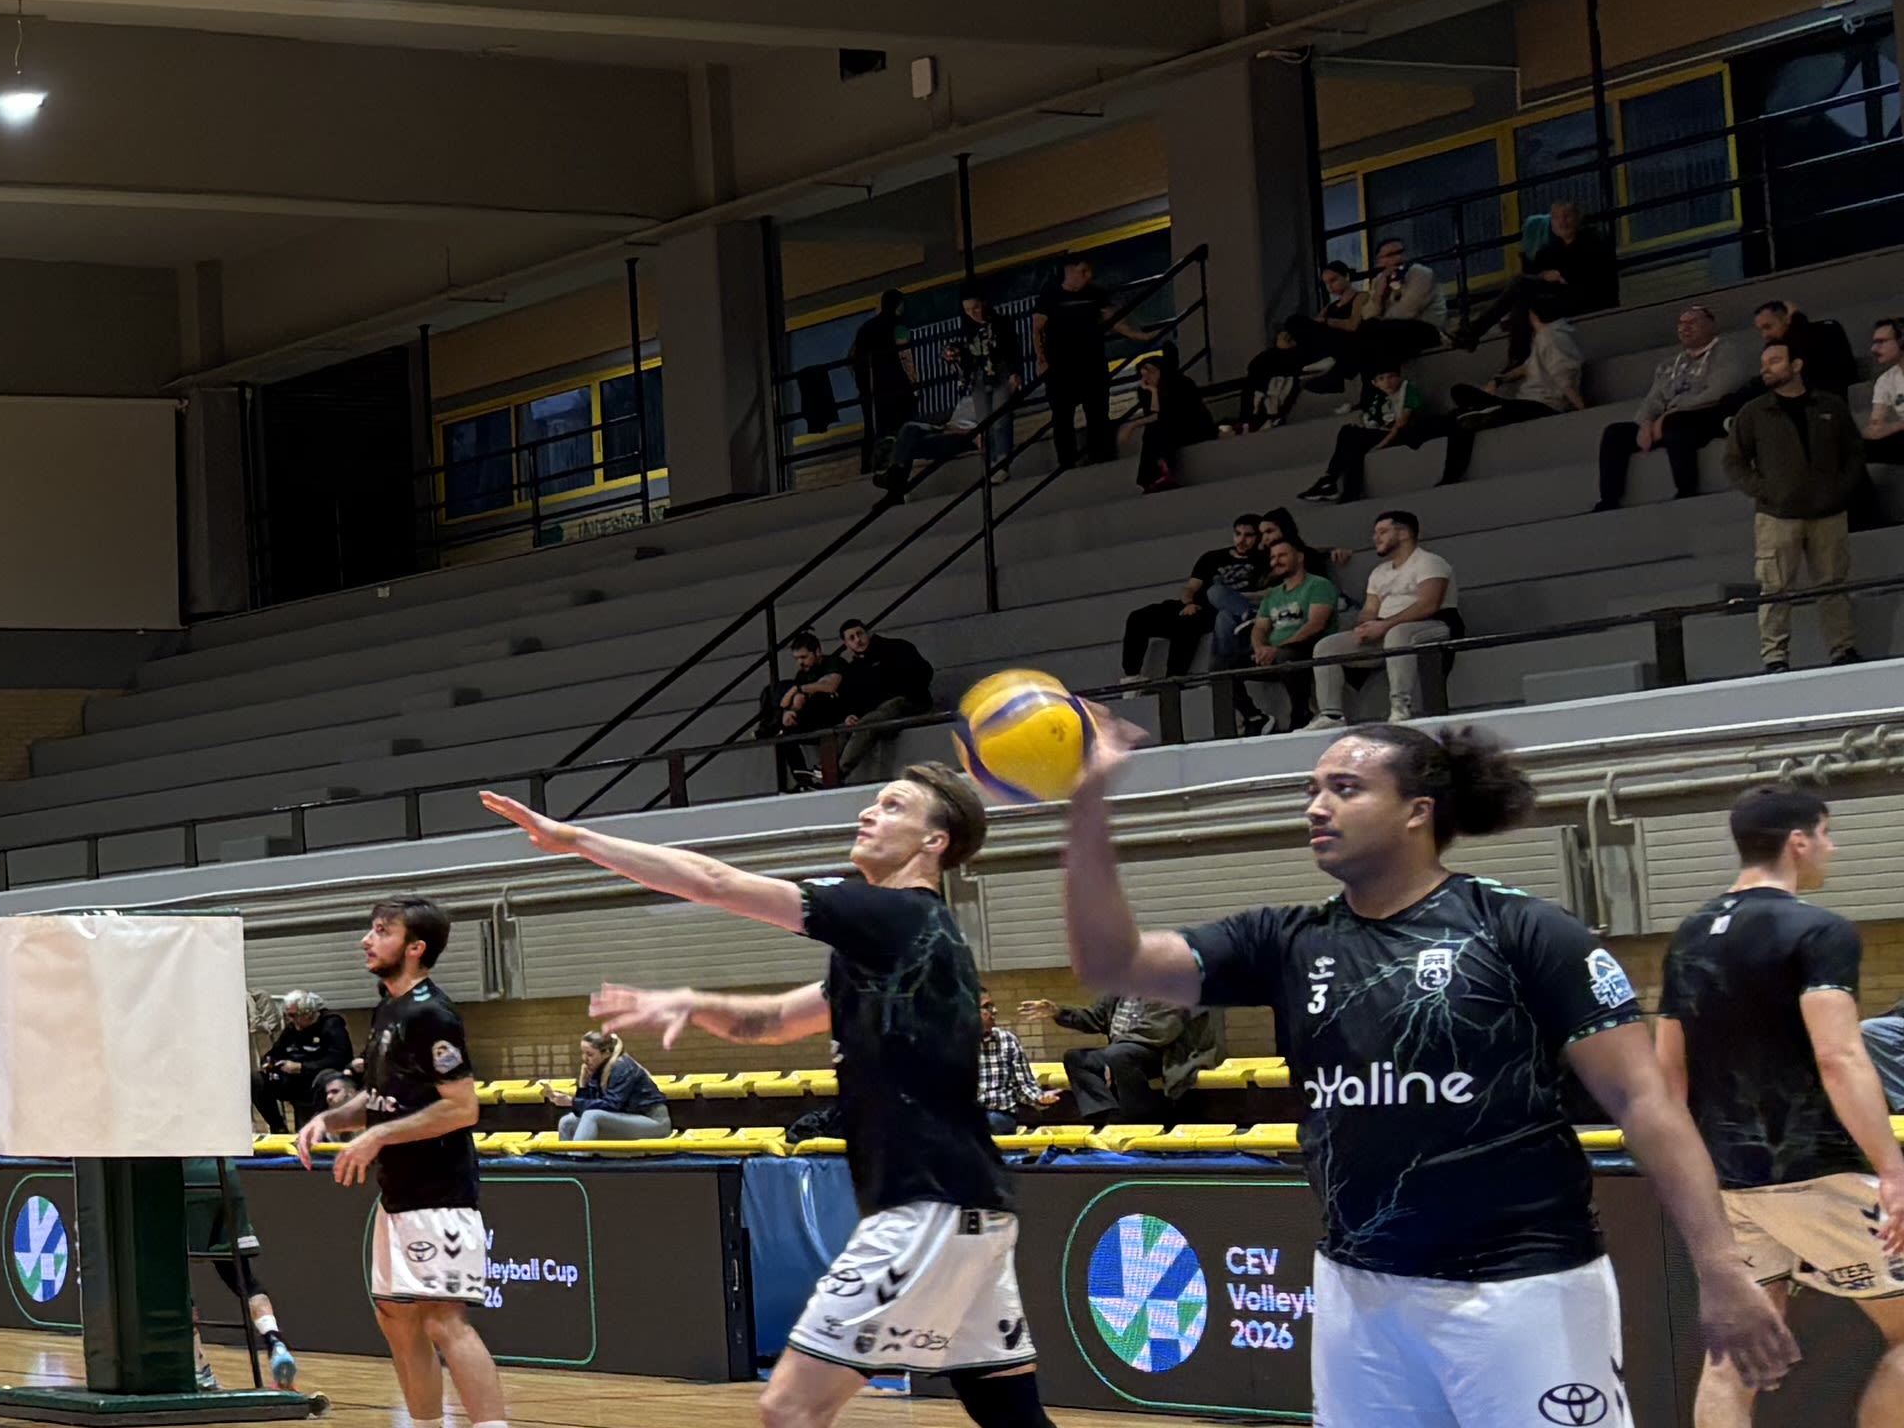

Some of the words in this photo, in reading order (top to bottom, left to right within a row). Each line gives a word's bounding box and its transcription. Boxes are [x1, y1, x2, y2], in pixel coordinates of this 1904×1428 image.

[1306, 983, 1330, 1015] 3
[543, 1258, 579, 1288] Cup
[1226, 1246, 1280, 1275] CEV
[483, 1285, 503, 1308] 26
[1230, 1319, 1294, 1350] 2026
